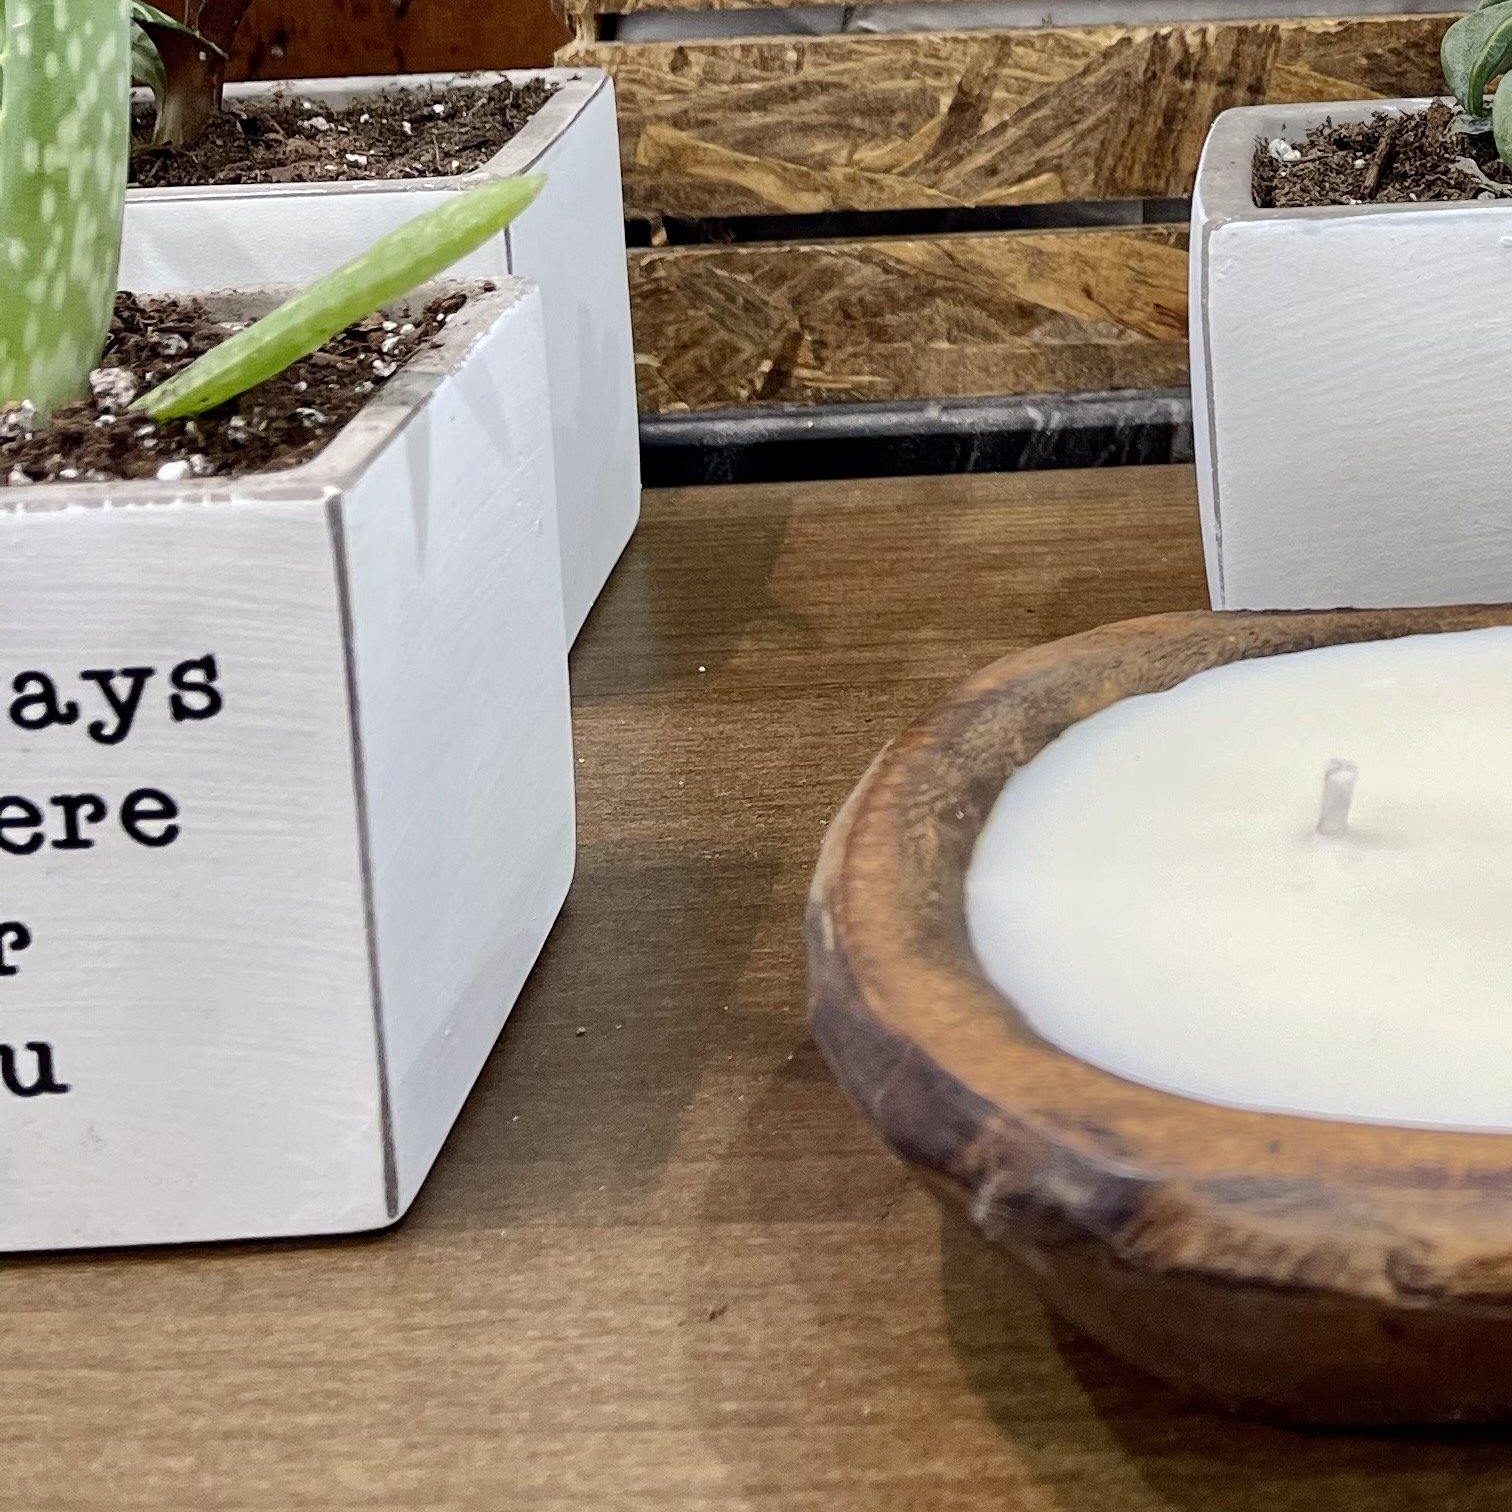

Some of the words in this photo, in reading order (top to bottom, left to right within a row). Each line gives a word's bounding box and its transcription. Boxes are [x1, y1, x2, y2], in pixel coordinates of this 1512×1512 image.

[9, 654, 223, 746] ays
[0, 787, 180, 856] ere
[0, 1041, 71, 1098] u
